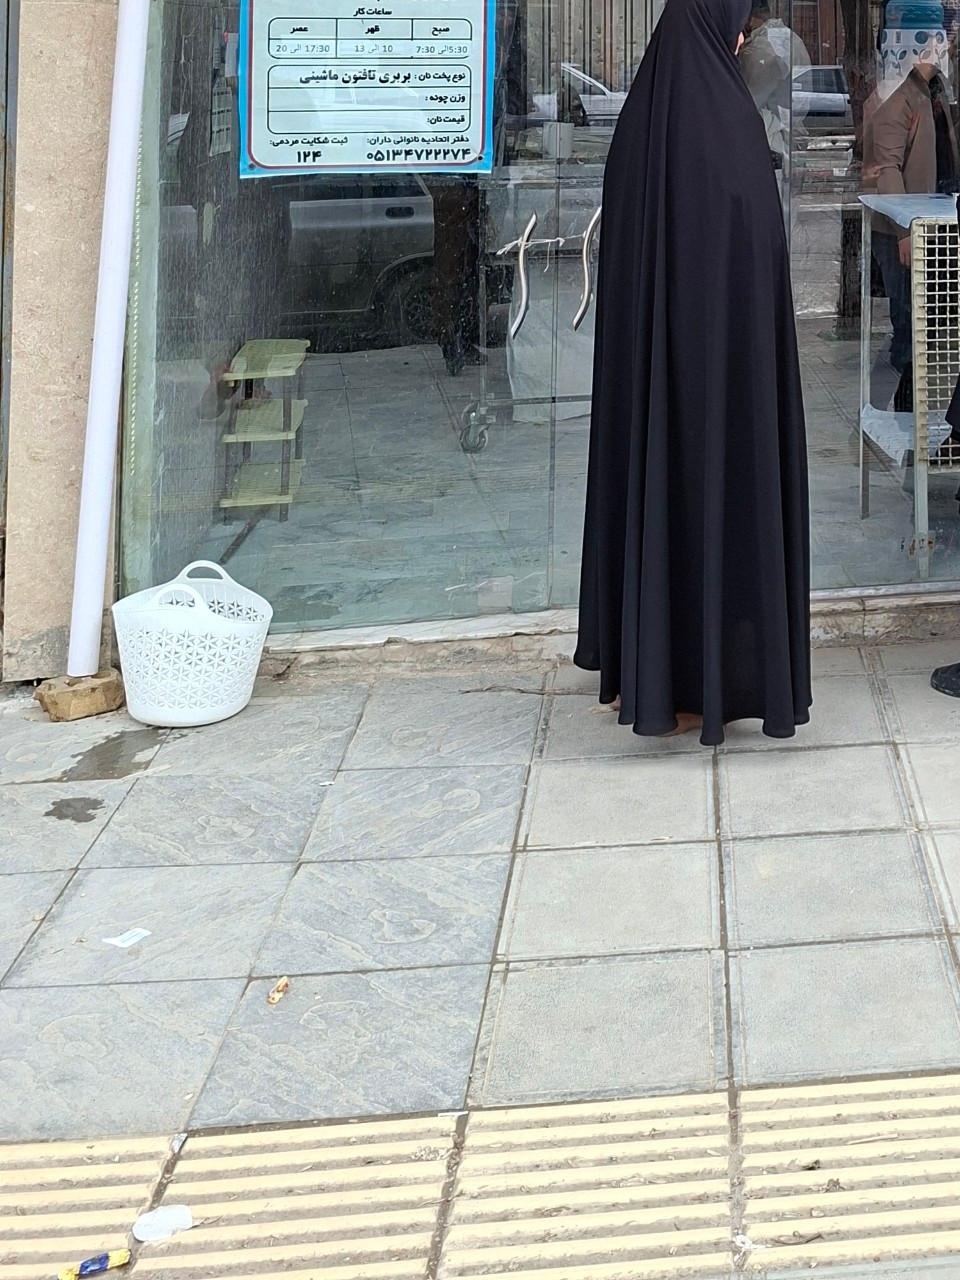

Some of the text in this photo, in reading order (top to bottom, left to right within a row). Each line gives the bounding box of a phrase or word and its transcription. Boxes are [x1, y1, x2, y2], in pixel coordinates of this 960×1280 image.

[353, 7, 393, 17] ساعات کار
[290, 24, 309, 34] عصر
[431, 25, 450, 36] صبح
[299, 69, 339, 84] ماشینی
[378, 70, 412, 84] بربری
[432, 72, 452, 83] پخت
[300, 136, 329, 146] شکایت
[331, 136, 349, 145] ثبت
[420, 136, 450, 145] اتحادیه
[451, 136, 470, 145] دفتر
[296, 149, 323, 163] ۱۲۴
